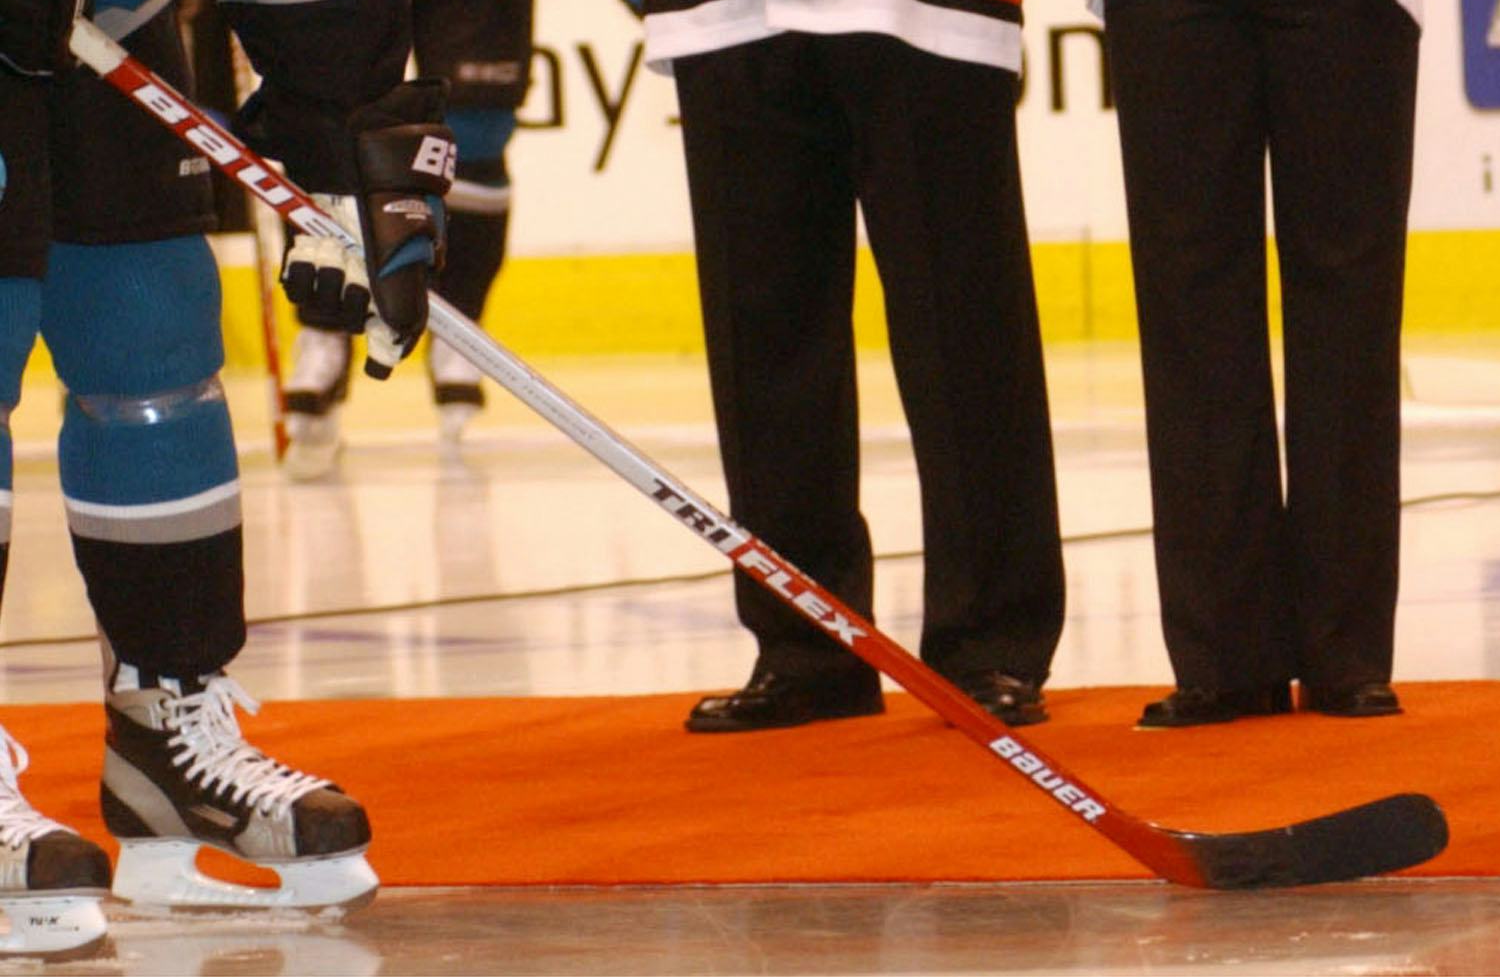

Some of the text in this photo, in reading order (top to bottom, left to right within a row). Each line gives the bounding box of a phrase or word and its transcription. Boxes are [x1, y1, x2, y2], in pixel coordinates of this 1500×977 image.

[650, 477, 870, 647] TRI FLEX
[988, 735, 1108, 824] BAUER
